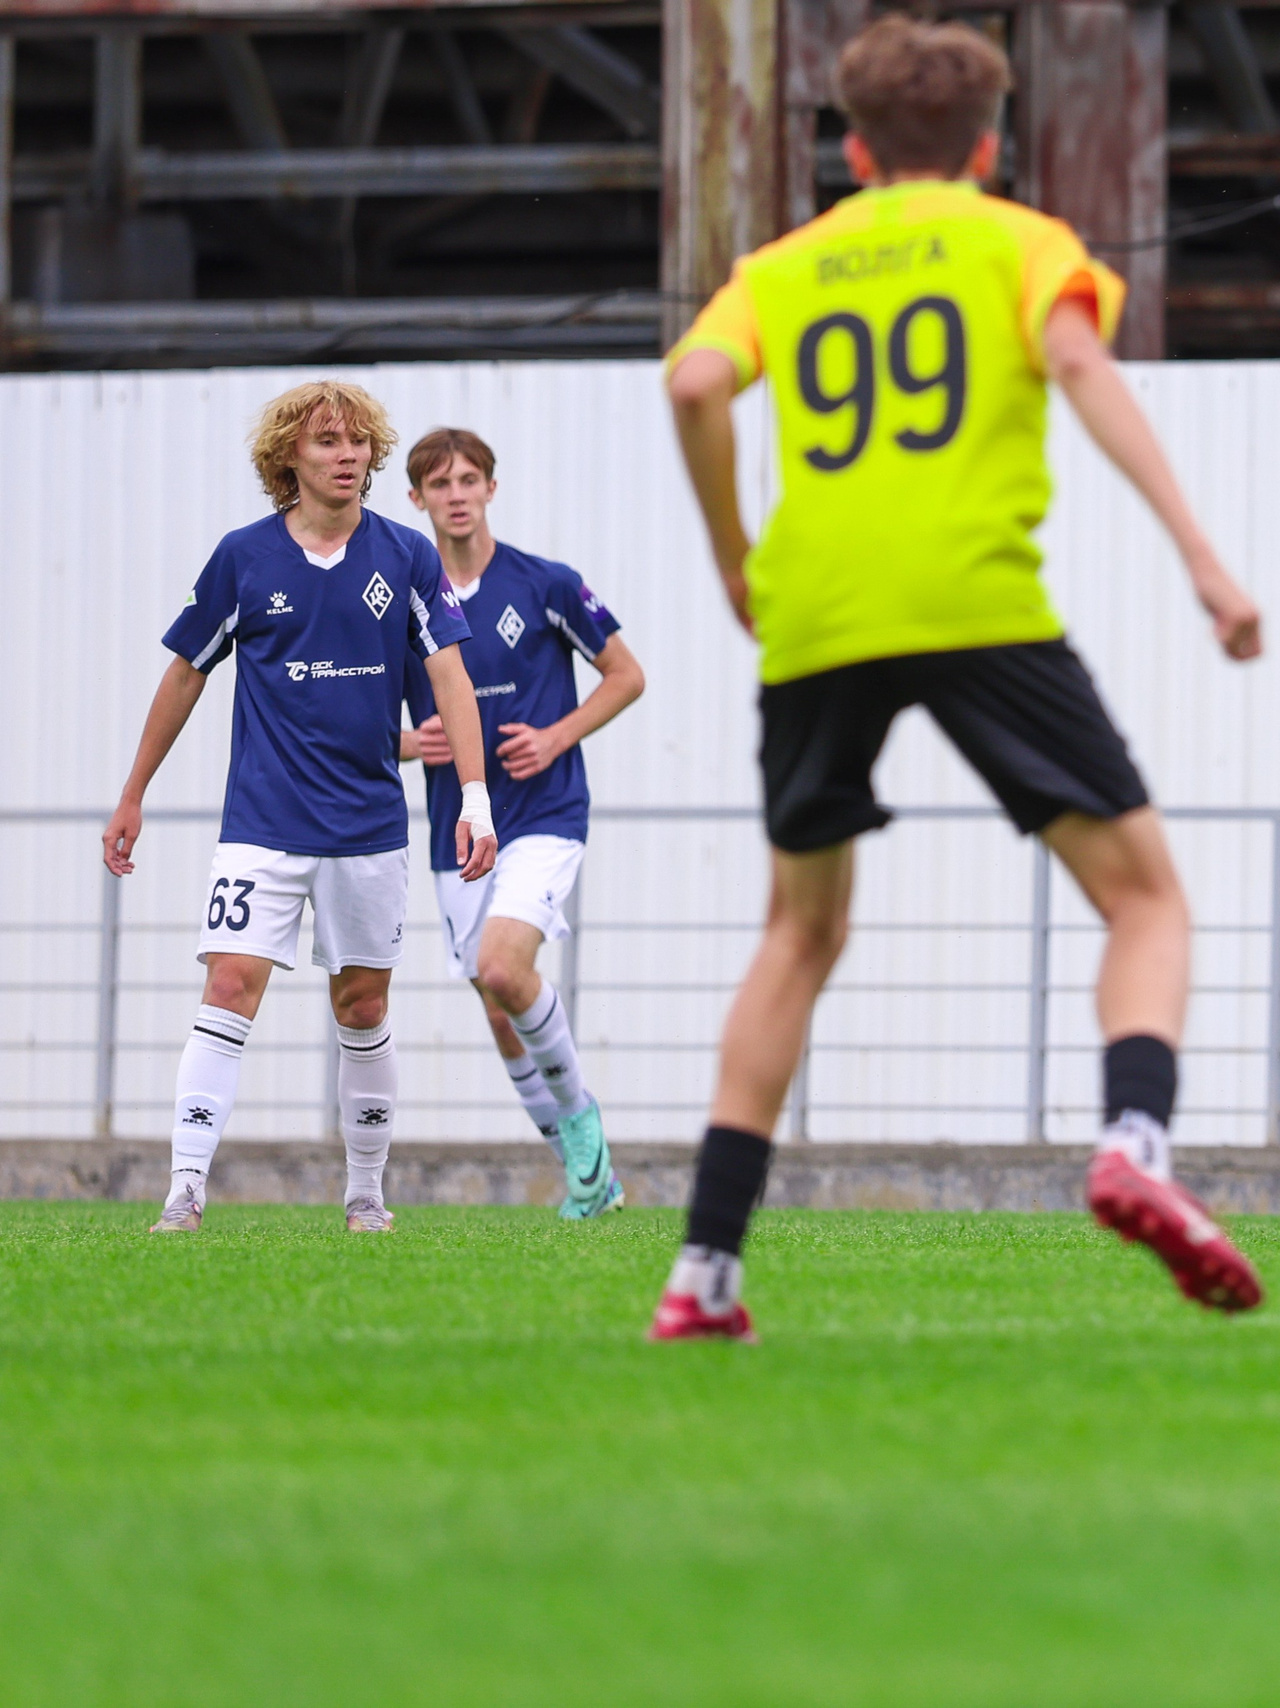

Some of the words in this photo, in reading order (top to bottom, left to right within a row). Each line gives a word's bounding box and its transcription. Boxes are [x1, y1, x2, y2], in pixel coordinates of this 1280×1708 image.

[817, 234, 947, 285] ВОЛГА
[796, 295, 968, 473] 99
[441, 590, 461, 608] W
[266, 605, 294, 616] KELME
[310, 660, 334, 671] ДСК
[310, 663, 386, 679] ТРАНССТРОЙ
[208, 877, 256, 932] 63
[182, 1117, 213, 1127] KELME
[356, 1117, 388, 1126] KELME
